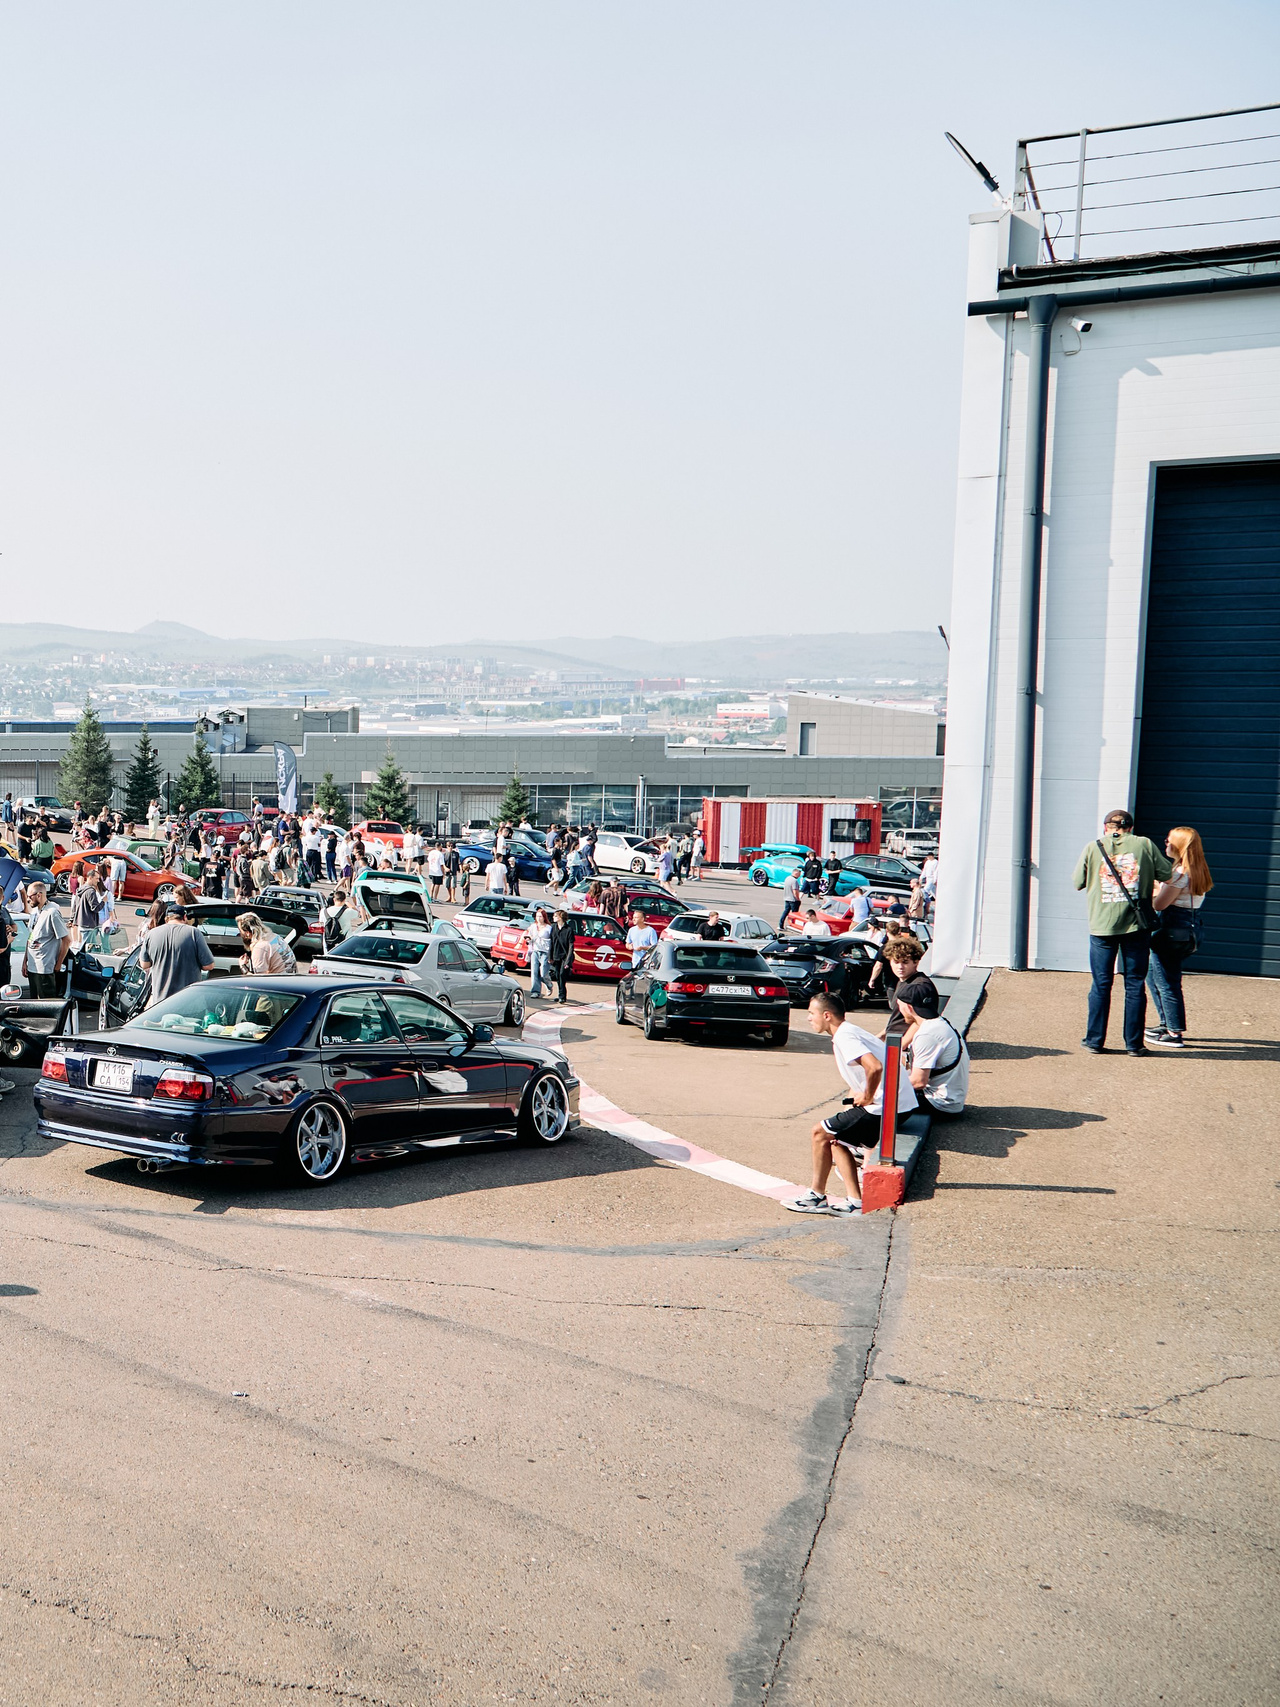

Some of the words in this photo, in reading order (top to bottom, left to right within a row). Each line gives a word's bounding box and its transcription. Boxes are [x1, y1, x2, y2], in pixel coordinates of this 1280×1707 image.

[112, 1064, 126, 1075] 116
[99, 1075, 111, 1086] СА
[119, 1077, 130, 1086] 154
